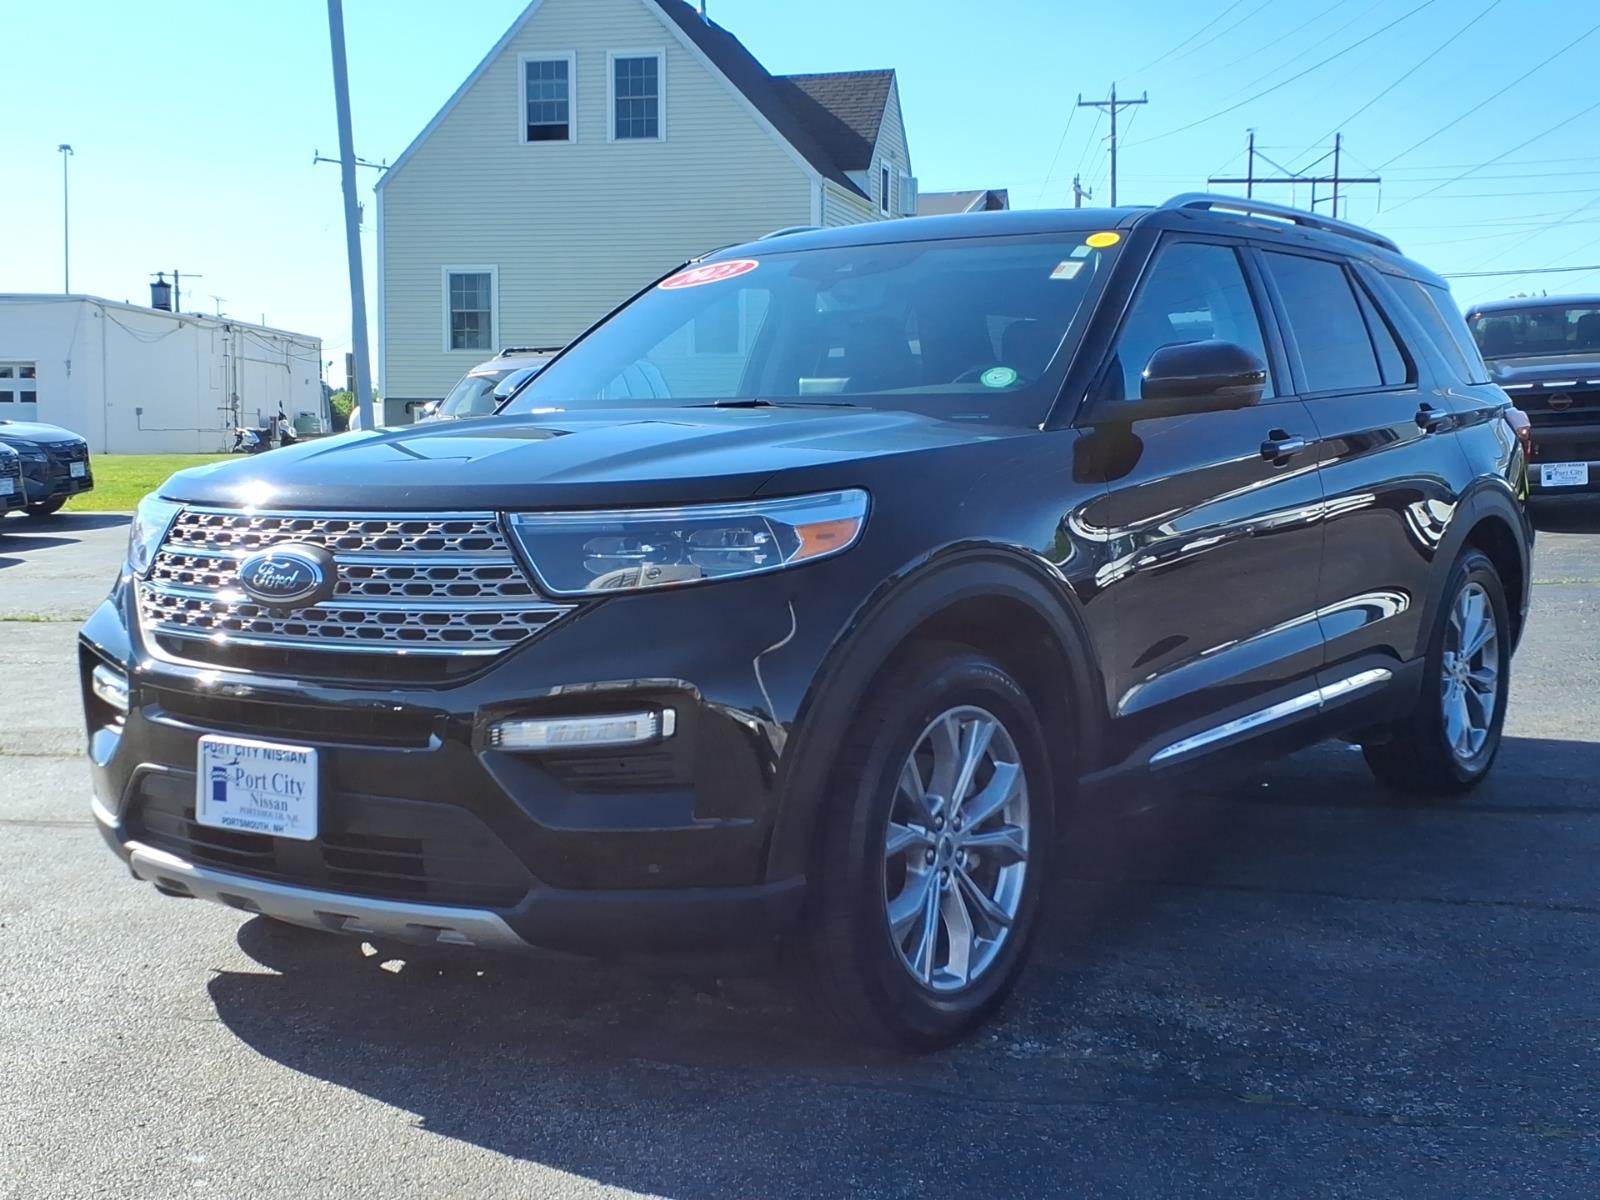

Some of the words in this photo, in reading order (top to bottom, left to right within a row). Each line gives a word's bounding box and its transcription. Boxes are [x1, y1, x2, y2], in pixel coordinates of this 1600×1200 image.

[253, 561, 299, 589] Ford
[203, 742, 229, 755] PORT
[235, 745, 258, 758] CITY
[263, 748, 307, 764] NISSAN
[235, 767, 262, 790] Port
[272, 772, 305, 800] City
[251, 792, 288, 811] Nissan
